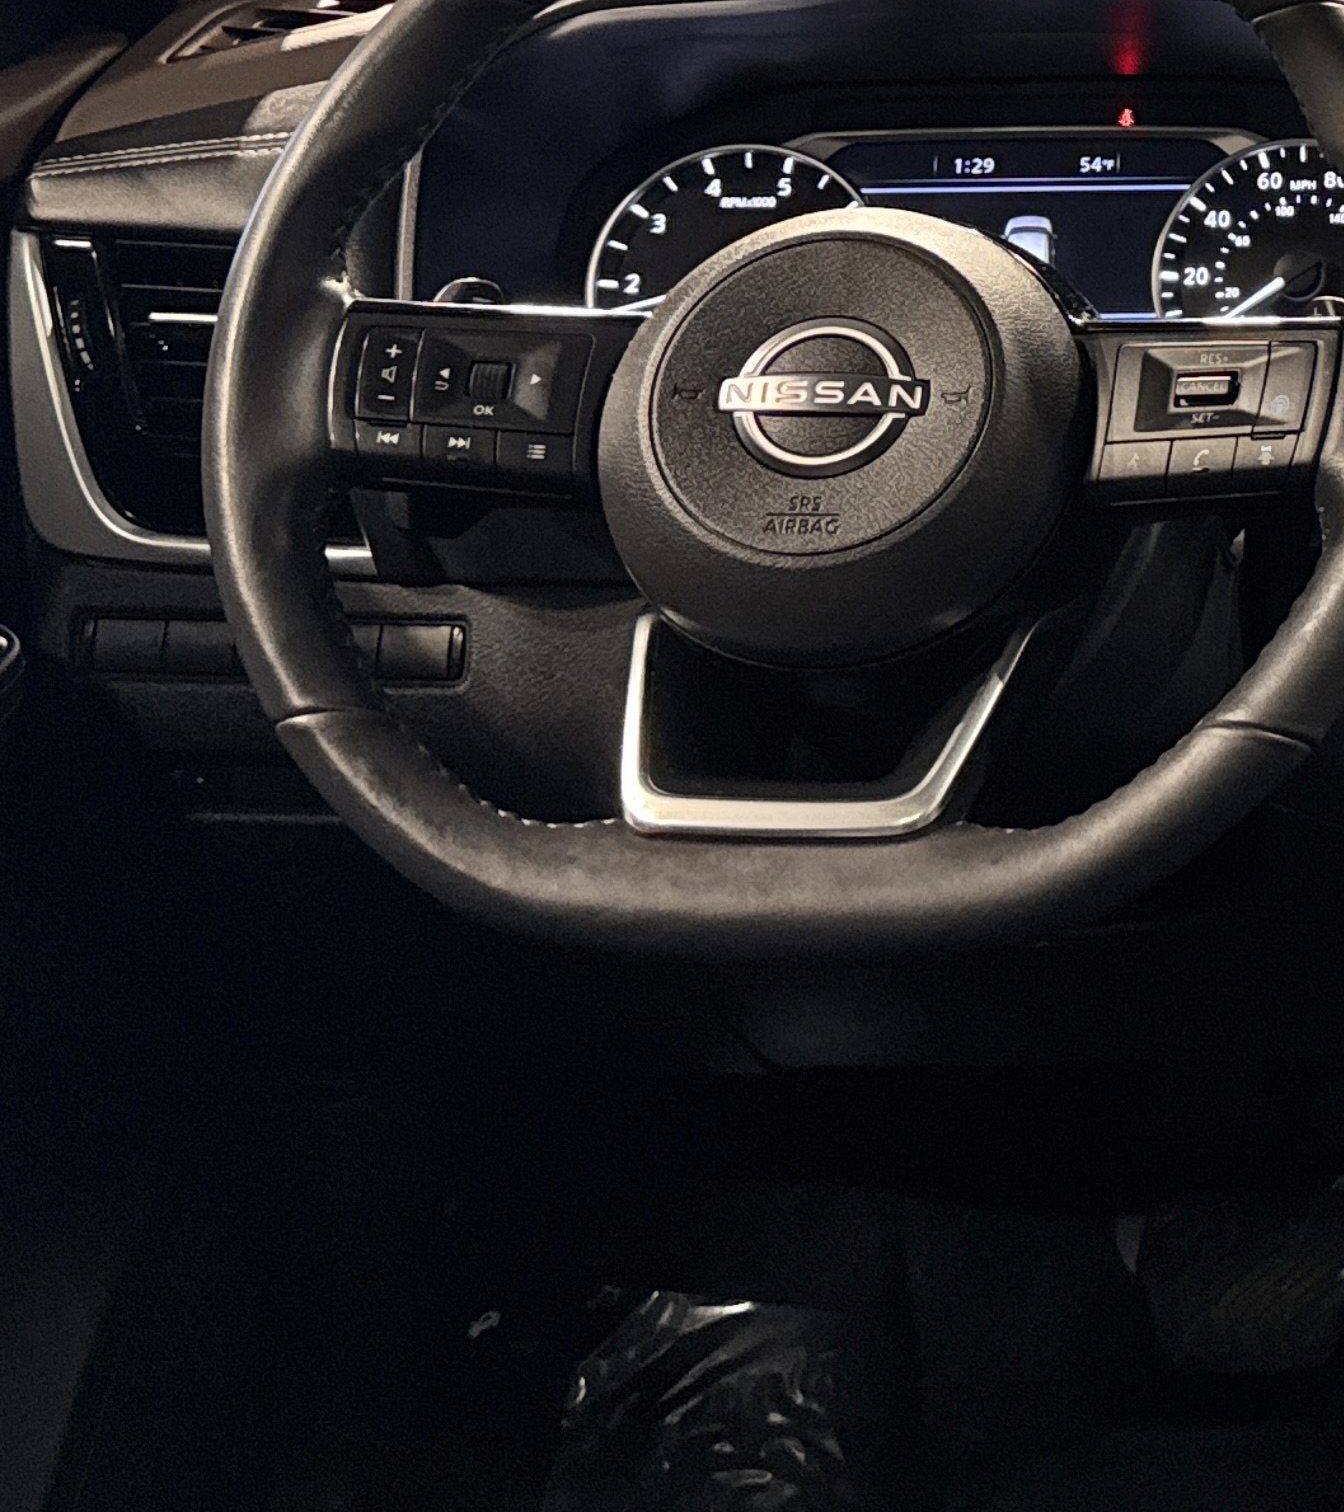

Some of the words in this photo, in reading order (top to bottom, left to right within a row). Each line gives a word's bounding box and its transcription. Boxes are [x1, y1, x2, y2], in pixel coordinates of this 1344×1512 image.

[953, 157, 995, 175] 1:29
[703, 178, 722, 198] 4
[776, 177, 793, 197] 5
[1256, 171, 1283, 190] 60
[1289, 179, 1317, 191] MPH
[1203, 209, 1231, 229] 40
[1274, 205, 1295, 218] 100
[650, 213, 667, 234] 3
[1234, 235, 1251, 248] 60
[622, 273, 641, 294] 2
[1183, 266, 1210, 286] 20
[1224, 287, 1240, 299] 20
[725, 380, 924, 410] NISSAN
[472, 403, 495, 417] OK
[787, 494, 823, 513] SRS
[762, 517, 841, 536] AIRBAG
